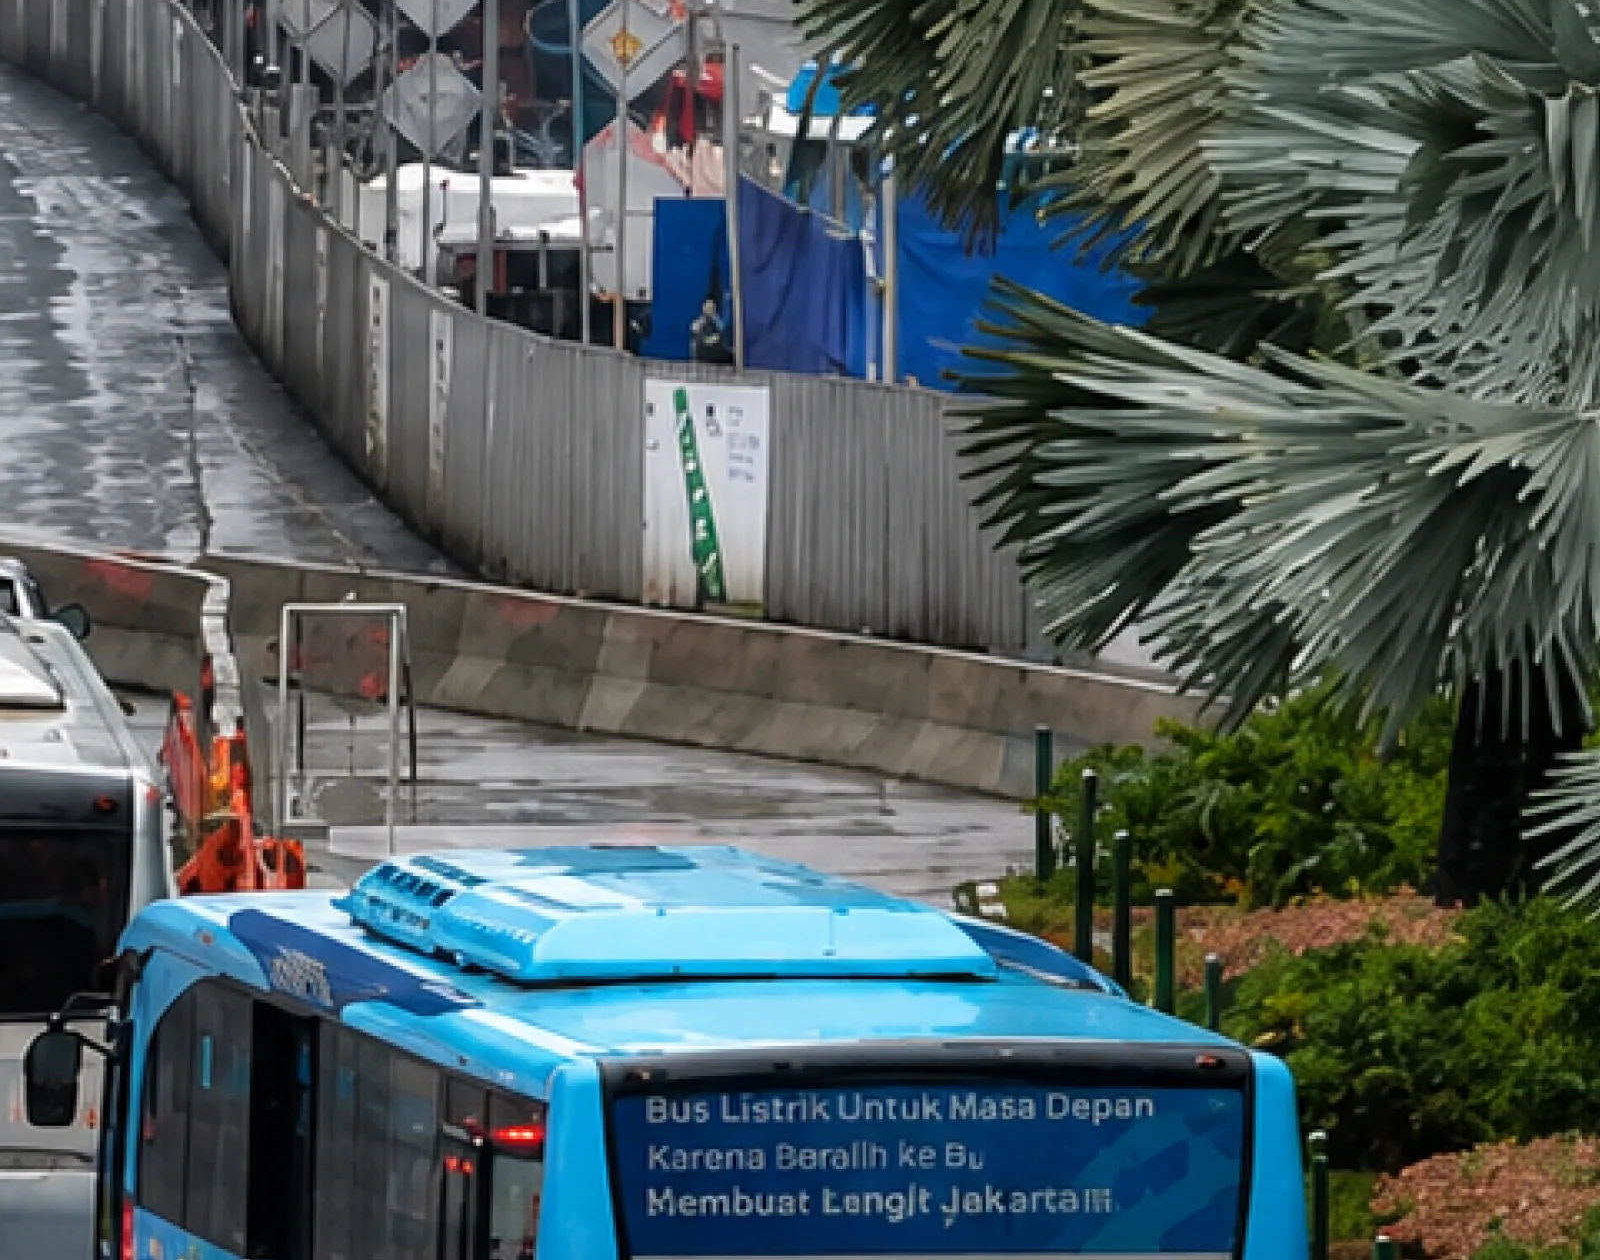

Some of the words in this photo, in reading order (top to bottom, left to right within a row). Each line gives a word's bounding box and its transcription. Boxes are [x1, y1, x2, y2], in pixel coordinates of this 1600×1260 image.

[646, 1095, 710, 1124] Bus
[838, 1091, 943, 1122] Untuk
[950, 1092, 1036, 1120] Masa
[1046, 1091, 1156, 1127] Depan
[899, 1140, 938, 1170] ke
[646, 1186, 810, 1217] Membuat
